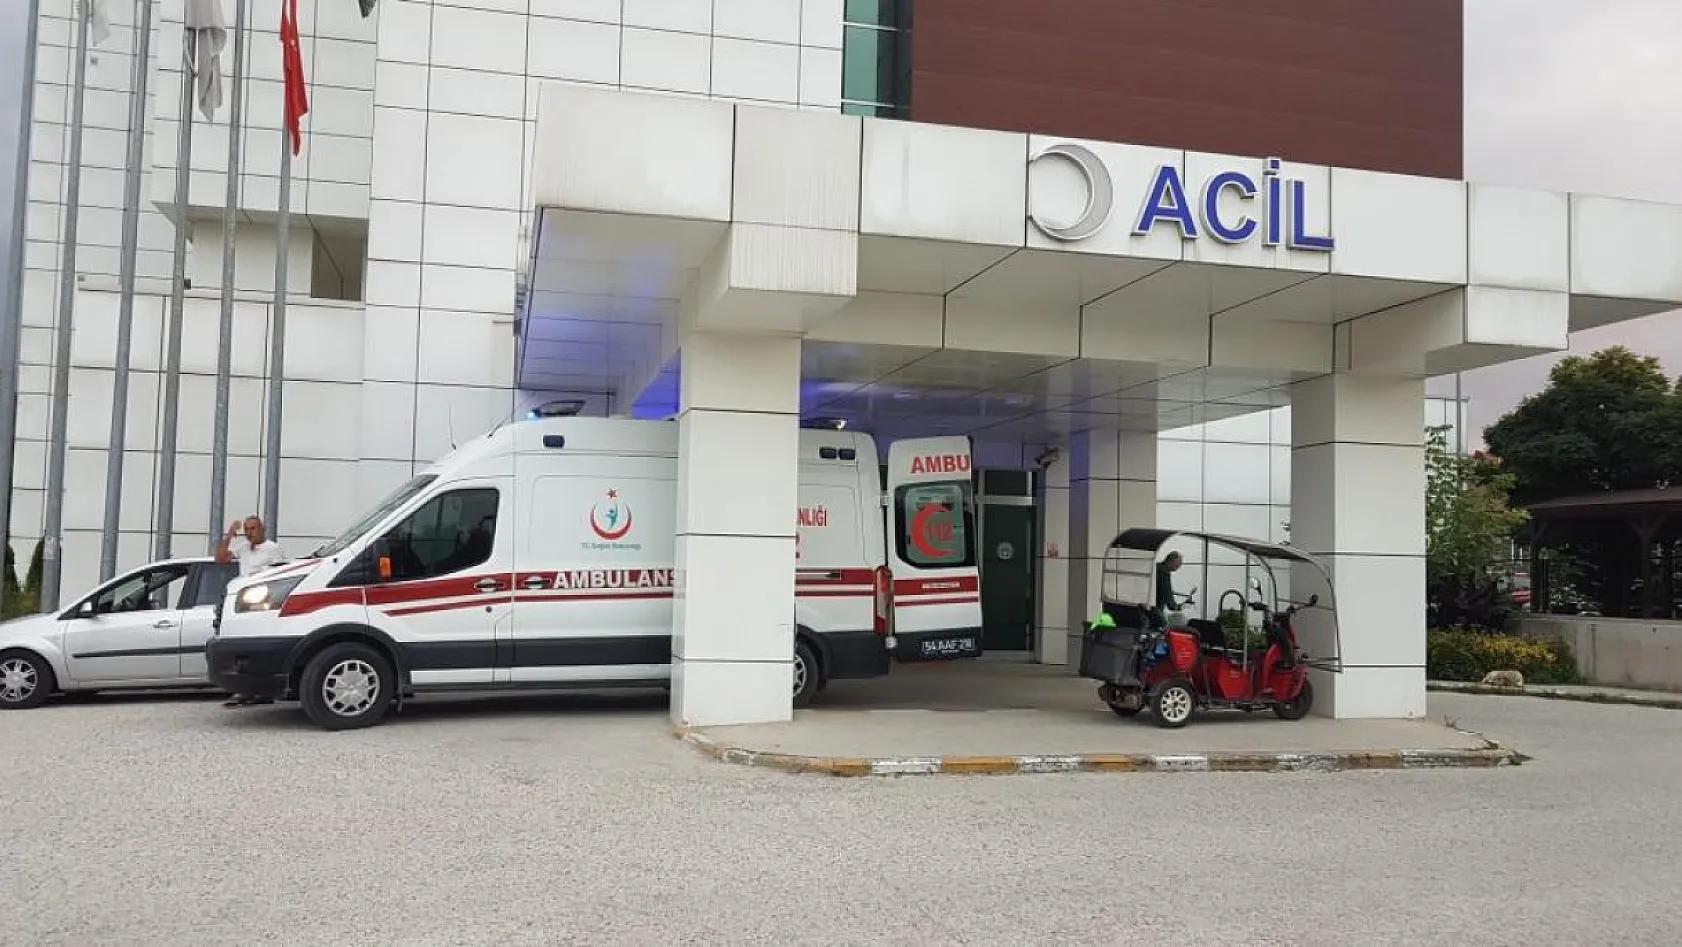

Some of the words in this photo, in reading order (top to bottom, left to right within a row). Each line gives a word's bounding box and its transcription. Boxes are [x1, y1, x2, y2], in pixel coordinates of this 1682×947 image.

[1131, 156, 1335, 251] ACİL
[909, 454, 970, 474] AMBU
[797, 504, 827, 527] NLIĞI
[553, 569, 673, 589] AMBULAN
